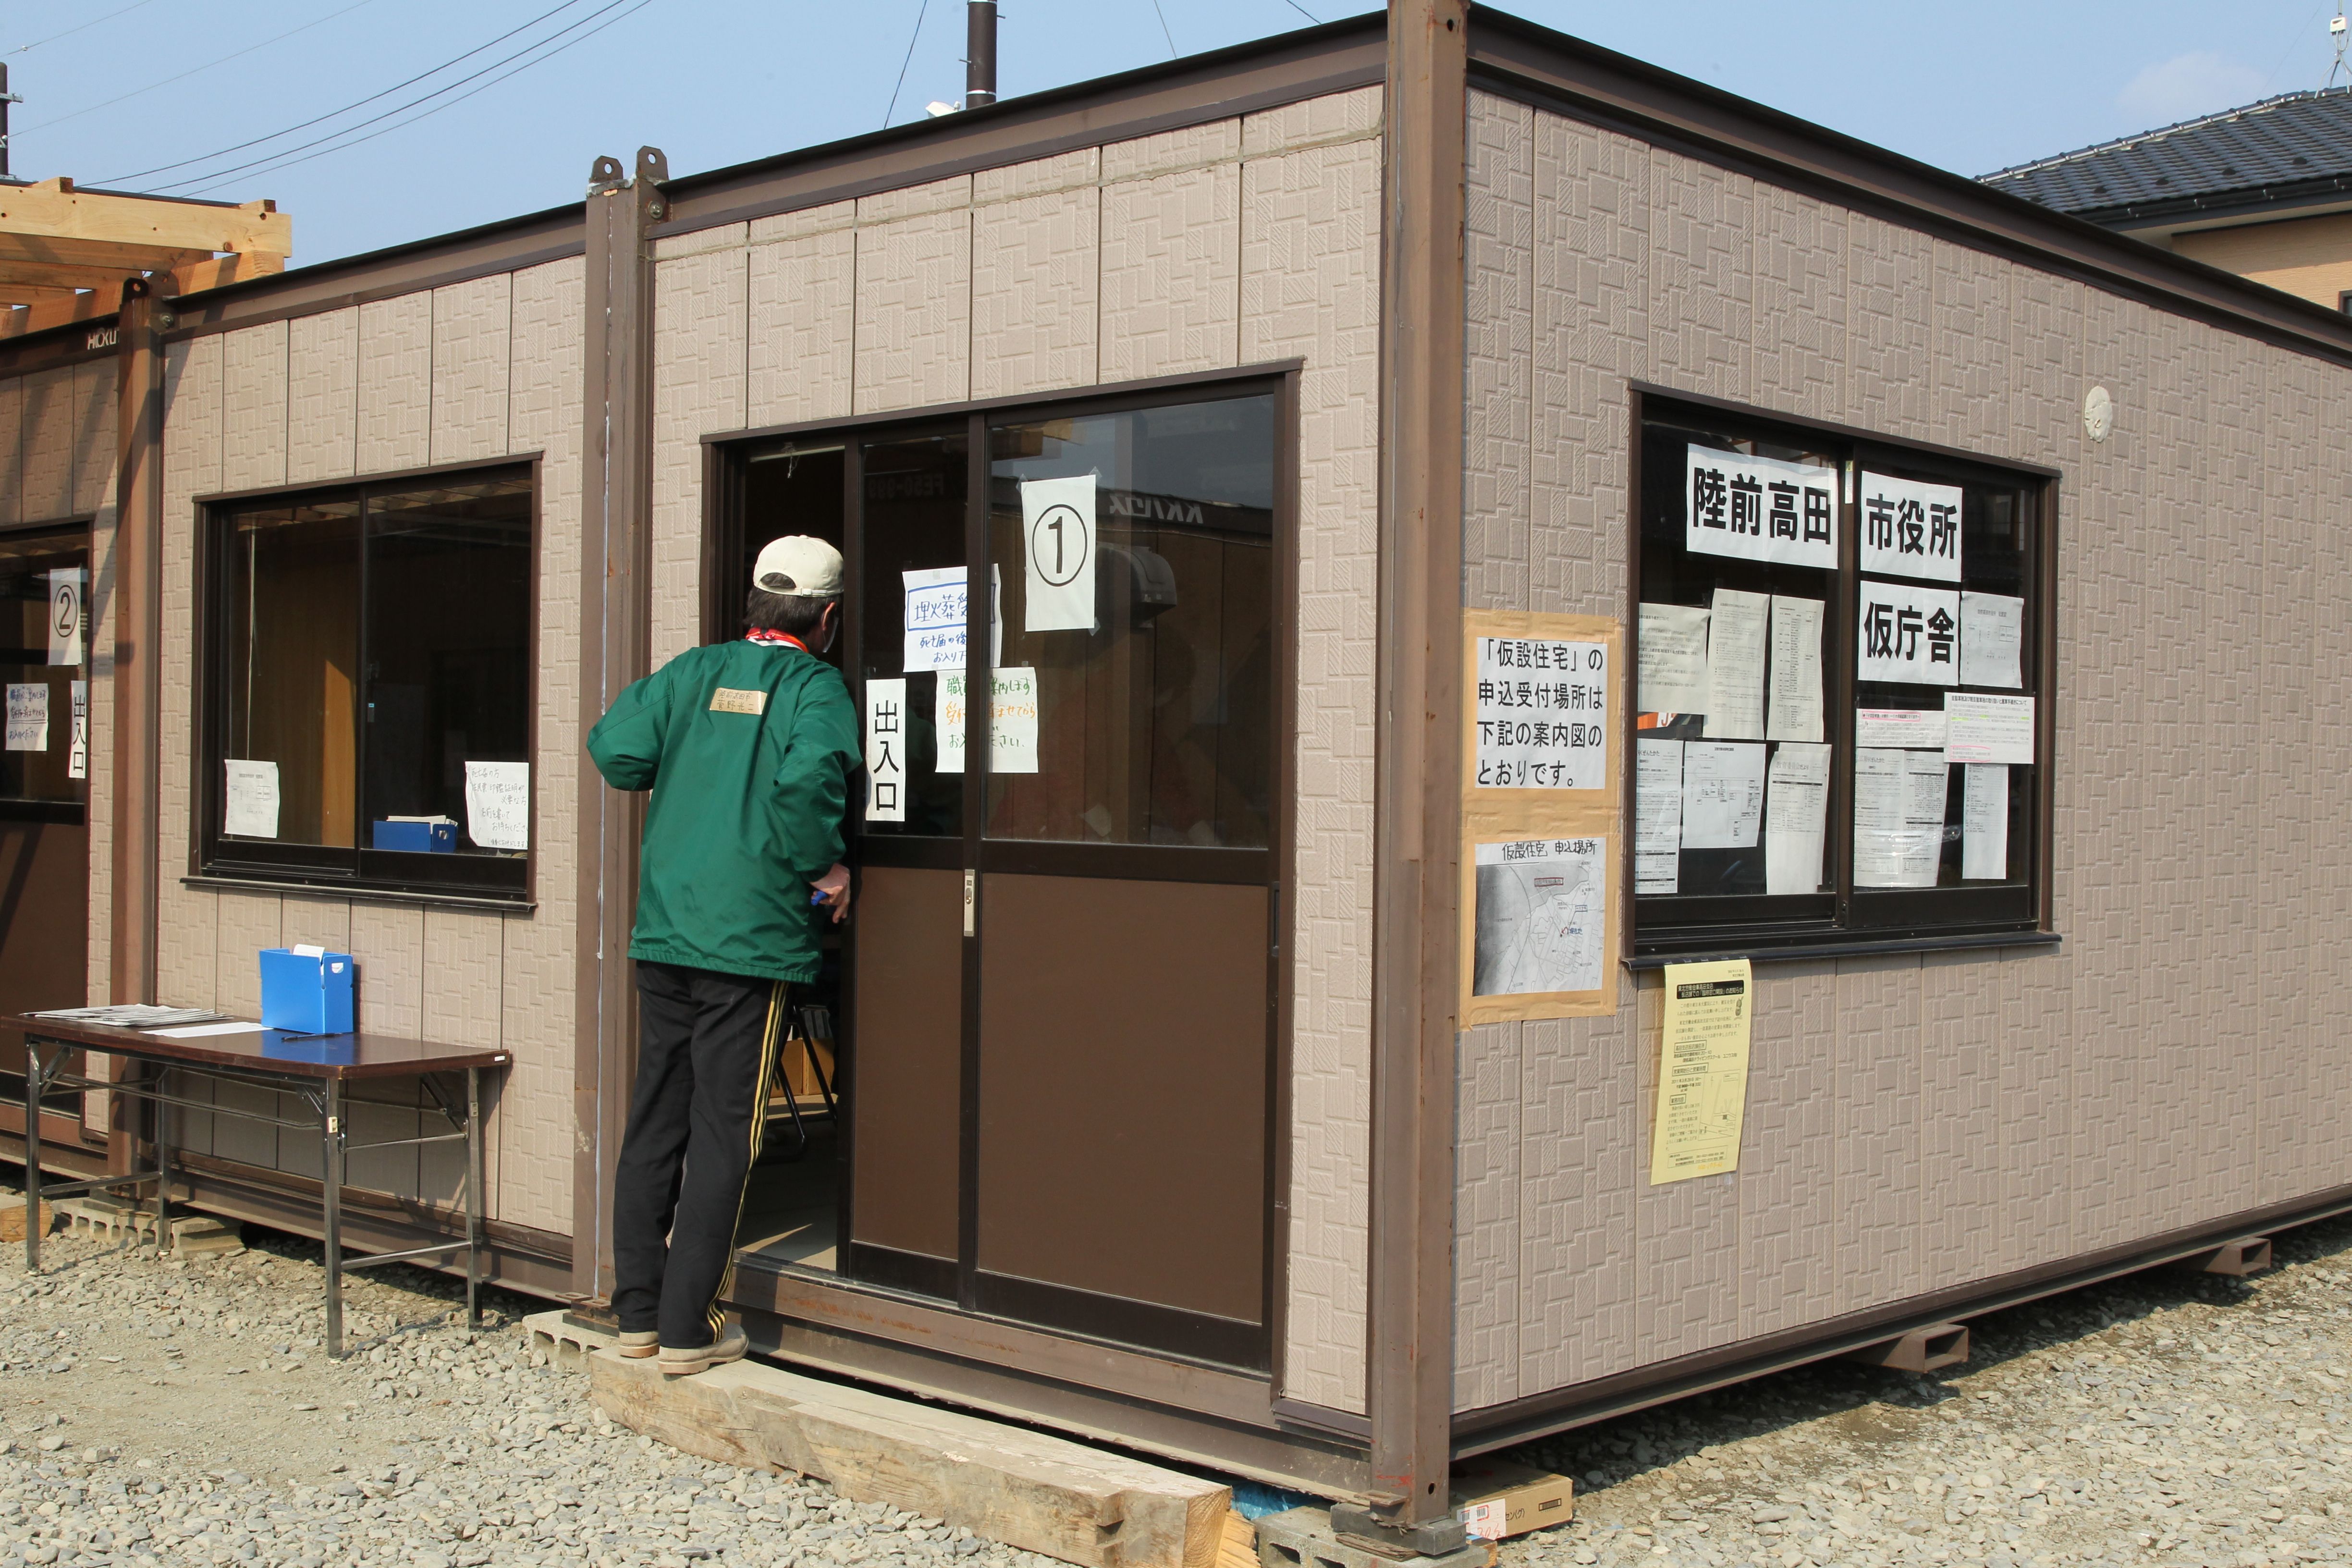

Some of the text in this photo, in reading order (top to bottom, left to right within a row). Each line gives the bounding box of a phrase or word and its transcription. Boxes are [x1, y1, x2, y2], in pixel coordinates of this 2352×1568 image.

[1693, 467, 1832, 545] 陸前高田
[1866, 493, 1958, 560] 市役所
[1488, 639, 1603, 671] 「仮設住宅」の
[1864, 601, 1955, 663] 仮庁舎
[1479, 679, 1603, 710] 申込受付場所は
[73, 695, 86, 771] 出入口
[873, 700, 899, 811] 出入口
[1477, 720, 1602, 748] 下記の案内図の
[1478, 759, 1573, 787] とおりです。
[1502, 841, 1548, 860] 仮設住宅
